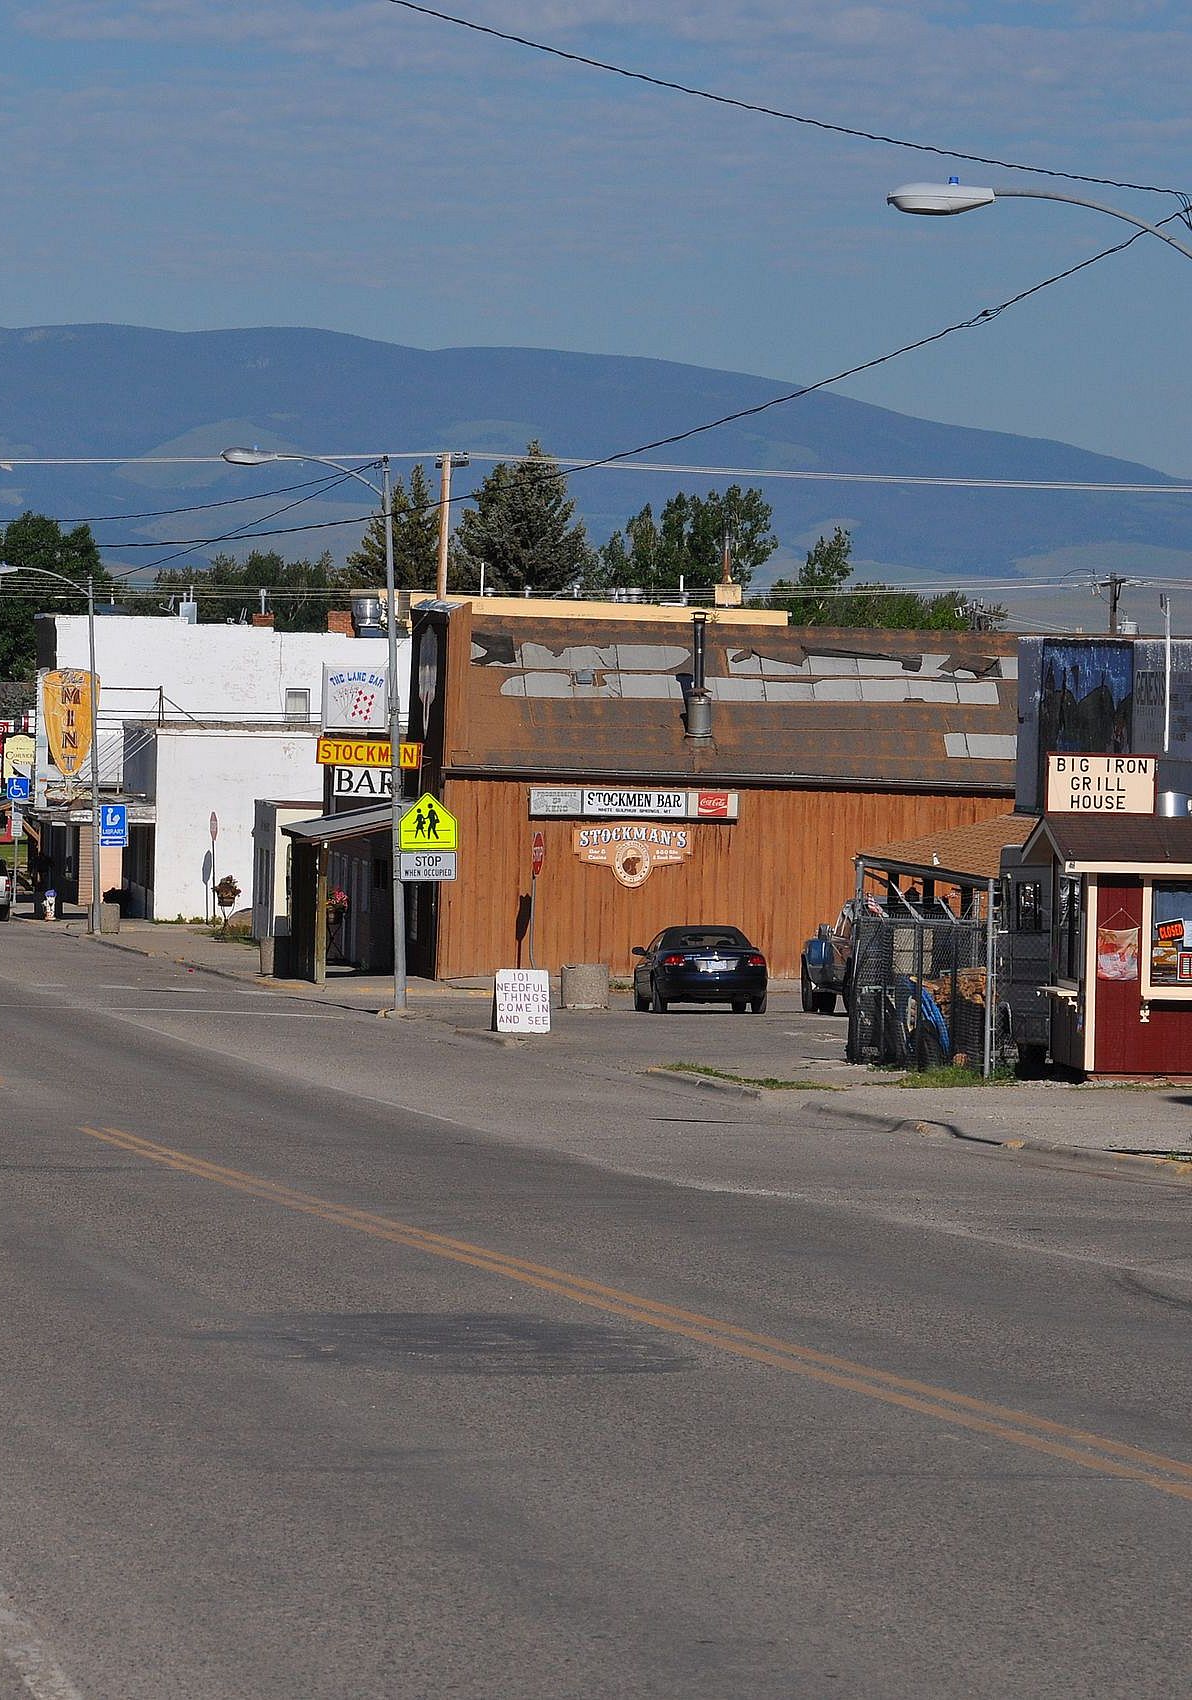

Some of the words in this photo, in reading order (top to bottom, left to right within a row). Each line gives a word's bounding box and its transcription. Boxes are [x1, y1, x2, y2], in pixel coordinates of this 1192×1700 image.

[329, 672, 346, 686] THE
[347, 671, 367, 682] LANE
[368, 673, 384, 688] BAR
[61, 687, 81, 771] MINT
[321, 744, 414, 763] STOCKMN
[1057, 758, 1090, 771] BIG
[1106, 758, 1148, 773] IRON
[1071, 776, 1126, 791] GRILL
[588, 792, 652, 807] STOCKMEN
[657, 794, 683, 808] BAR
[1071, 795, 1126, 810] HOUSE
[579, 826, 687, 849] STOCKMAN'S
[415, 856, 442, 867] STOP
[404, 869, 421, 877] WHEN
[423, 869, 452, 877] OCCUPIED
[1159, 923, 1183, 939] CLOSED
[512, 973, 529, 981] 101
[497, 983, 547, 992] NEEDFUL
[503, 993, 548, 1002] THINGS
[498, 1003, 531, 1012] COME
[536, 1003, 549, 1012] IN
[498, 1015, 520, 1024] AND
[528, 1015, 549, 1025] SEE
